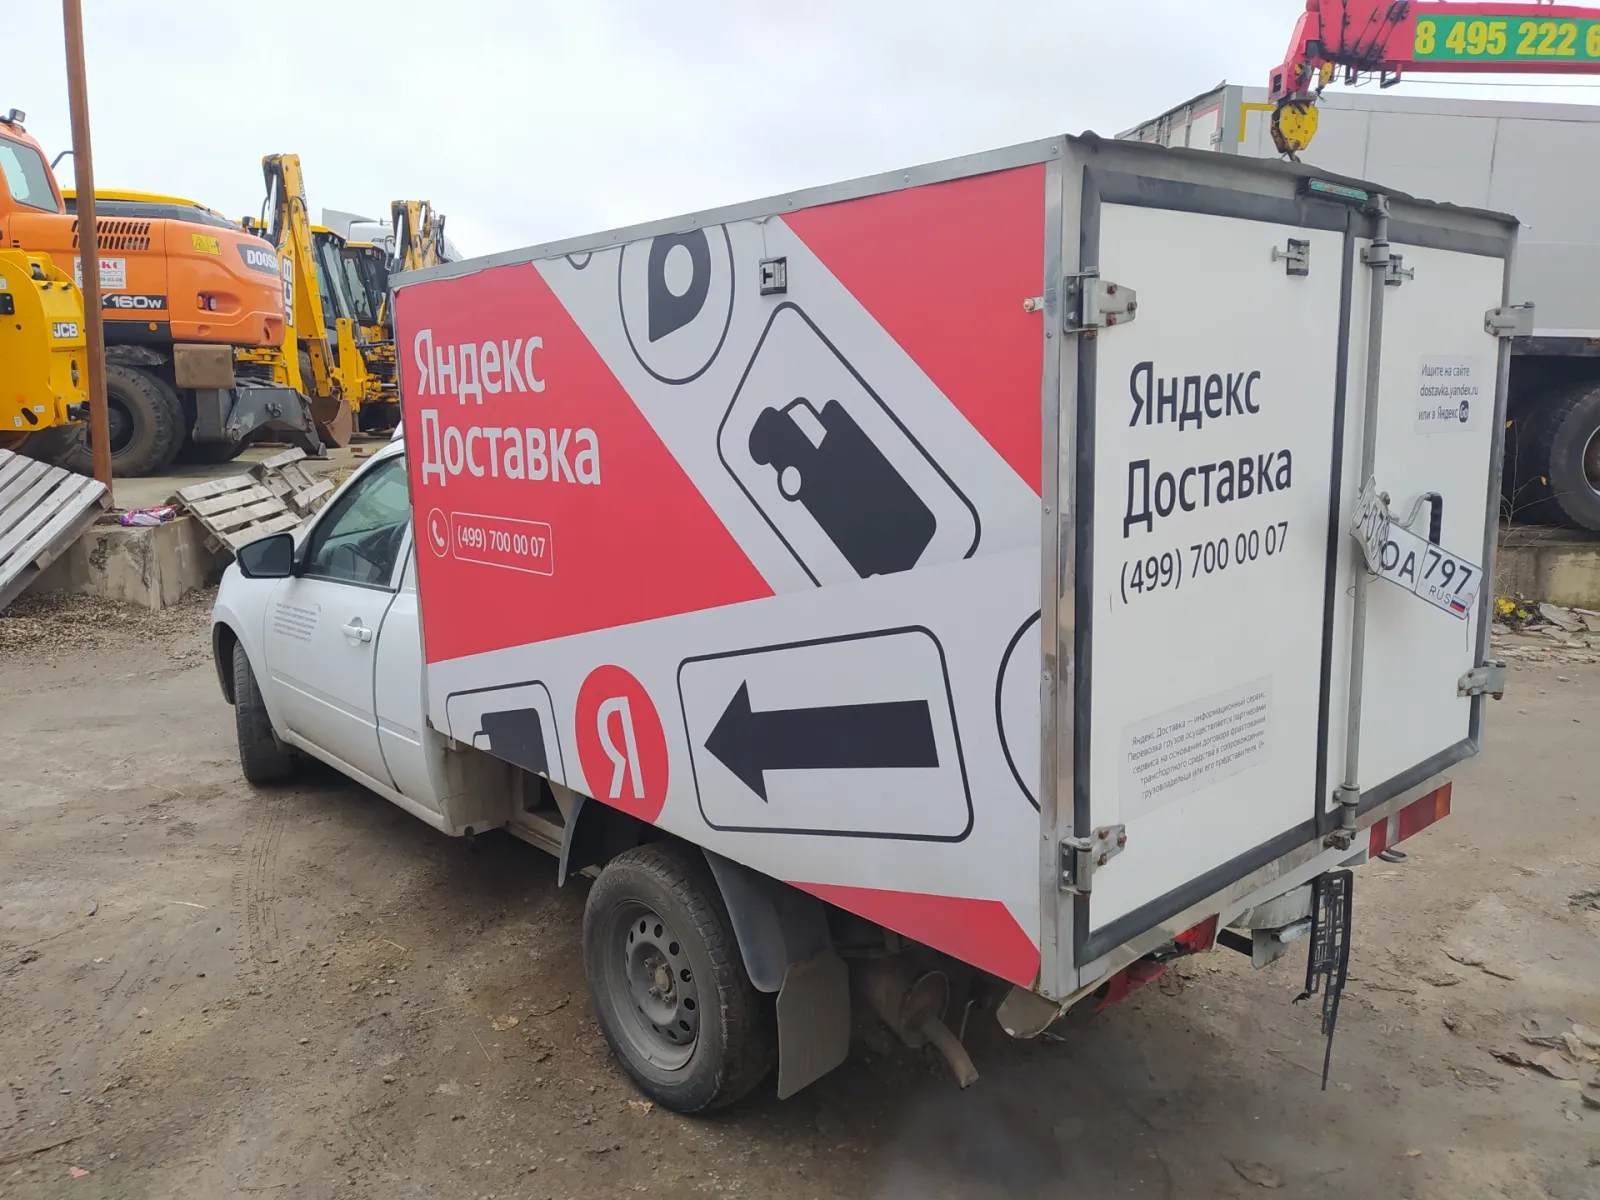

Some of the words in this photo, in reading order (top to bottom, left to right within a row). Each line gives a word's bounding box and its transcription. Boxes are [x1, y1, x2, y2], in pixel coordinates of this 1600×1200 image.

[1415, 21, 1435, 54] 8
[1446, 21, 1506, 55] 495
[1516, 22, 1577, 57] 222
[283, 257, 293, 327] JCB
[53, 323, 78, 337] JCB
[414, 329, 546, 405] Яндекс
[1421, 363, 1443, 378] Ищите
[1444, 366, 1452, 376] на
[1453, 364, 1470, 377] сайте
[1128, 361, 1261, 432] Яндекс
[1420, 383, 1479, 399] dostavka.yandex.ru
[1418, 410, 1431, 420] или
[1431, 410, 1436, 420] в
[1437, 405, 1459, 421] Яндекс
[420, 409, 601, 487] Доставка
[1123, 448, 1293, 538] Доставка
[457, 524, 487, 552] (499)
[489, 530, 511, 553] 700
[513, 534, 528, 556] 00
[530, 537, 546, 558] 07
[1120, 548, 1183, 604] (499)
[1191, 537, 1228, 579] 700
[1235, 529, 1260, 566] 00
[1265, 521, 1289, 554] 07
[1423, 549, 1473, 595] 797
[1429, 585, 1451, 605] RUS
[597, 696, 646, 799] Я
[1127, 743, 1163, 763] Перевозка
[1163, 734, 1185, 749] грузов
[1132, 731, 1156, 747] Яндекс
[1157, 720, 1186, 739] Доставка
[1160, 754, 1168, 763] на
[1204, 762, 1215, 772] его
